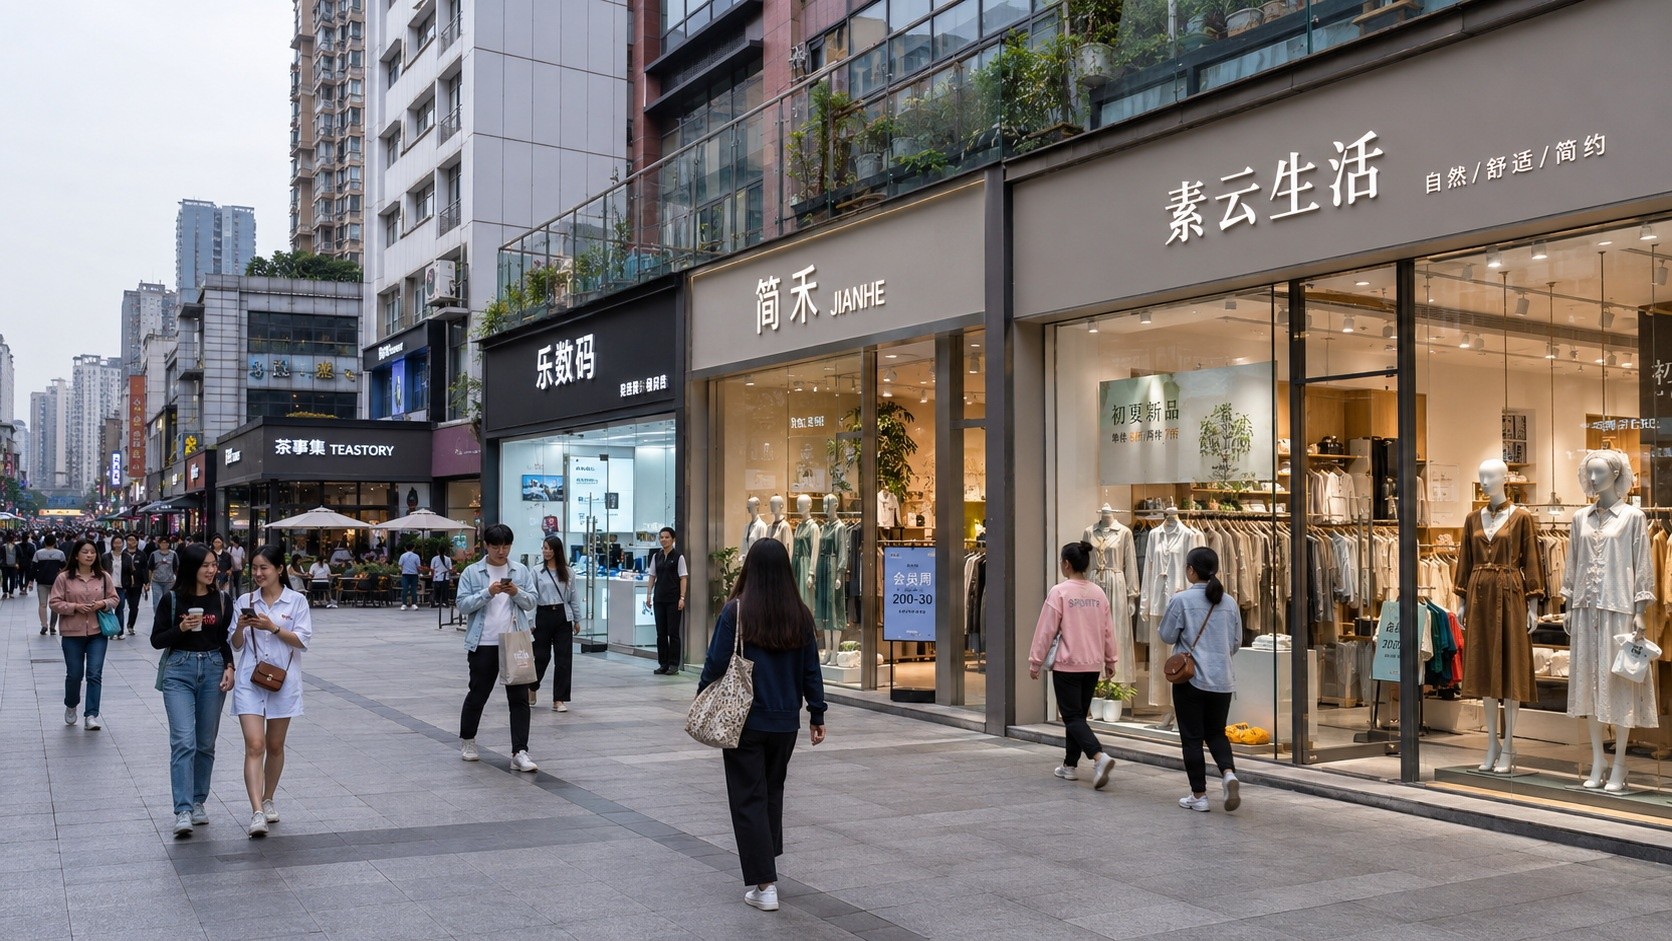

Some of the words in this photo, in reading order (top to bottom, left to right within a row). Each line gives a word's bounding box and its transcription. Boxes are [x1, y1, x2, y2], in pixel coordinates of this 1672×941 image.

[1426, 133, 1606, 194] 自然/舒适/简约
[1164, 130, 1384, 246] 素云生活
[755, 263, 818, 335] 简禾
[830, 279, 886, 316] JIANHE
[535, 333, 595, 390] 乐数码
[1112, 399, 1179, 426] 初夏新品
[275, 438, 326, 456] 茶事集
[329, 444, 395, 457] TEASTORY
[893, 571, 932, 587] 会员周
[892, 593, 933, 605] 200-30
